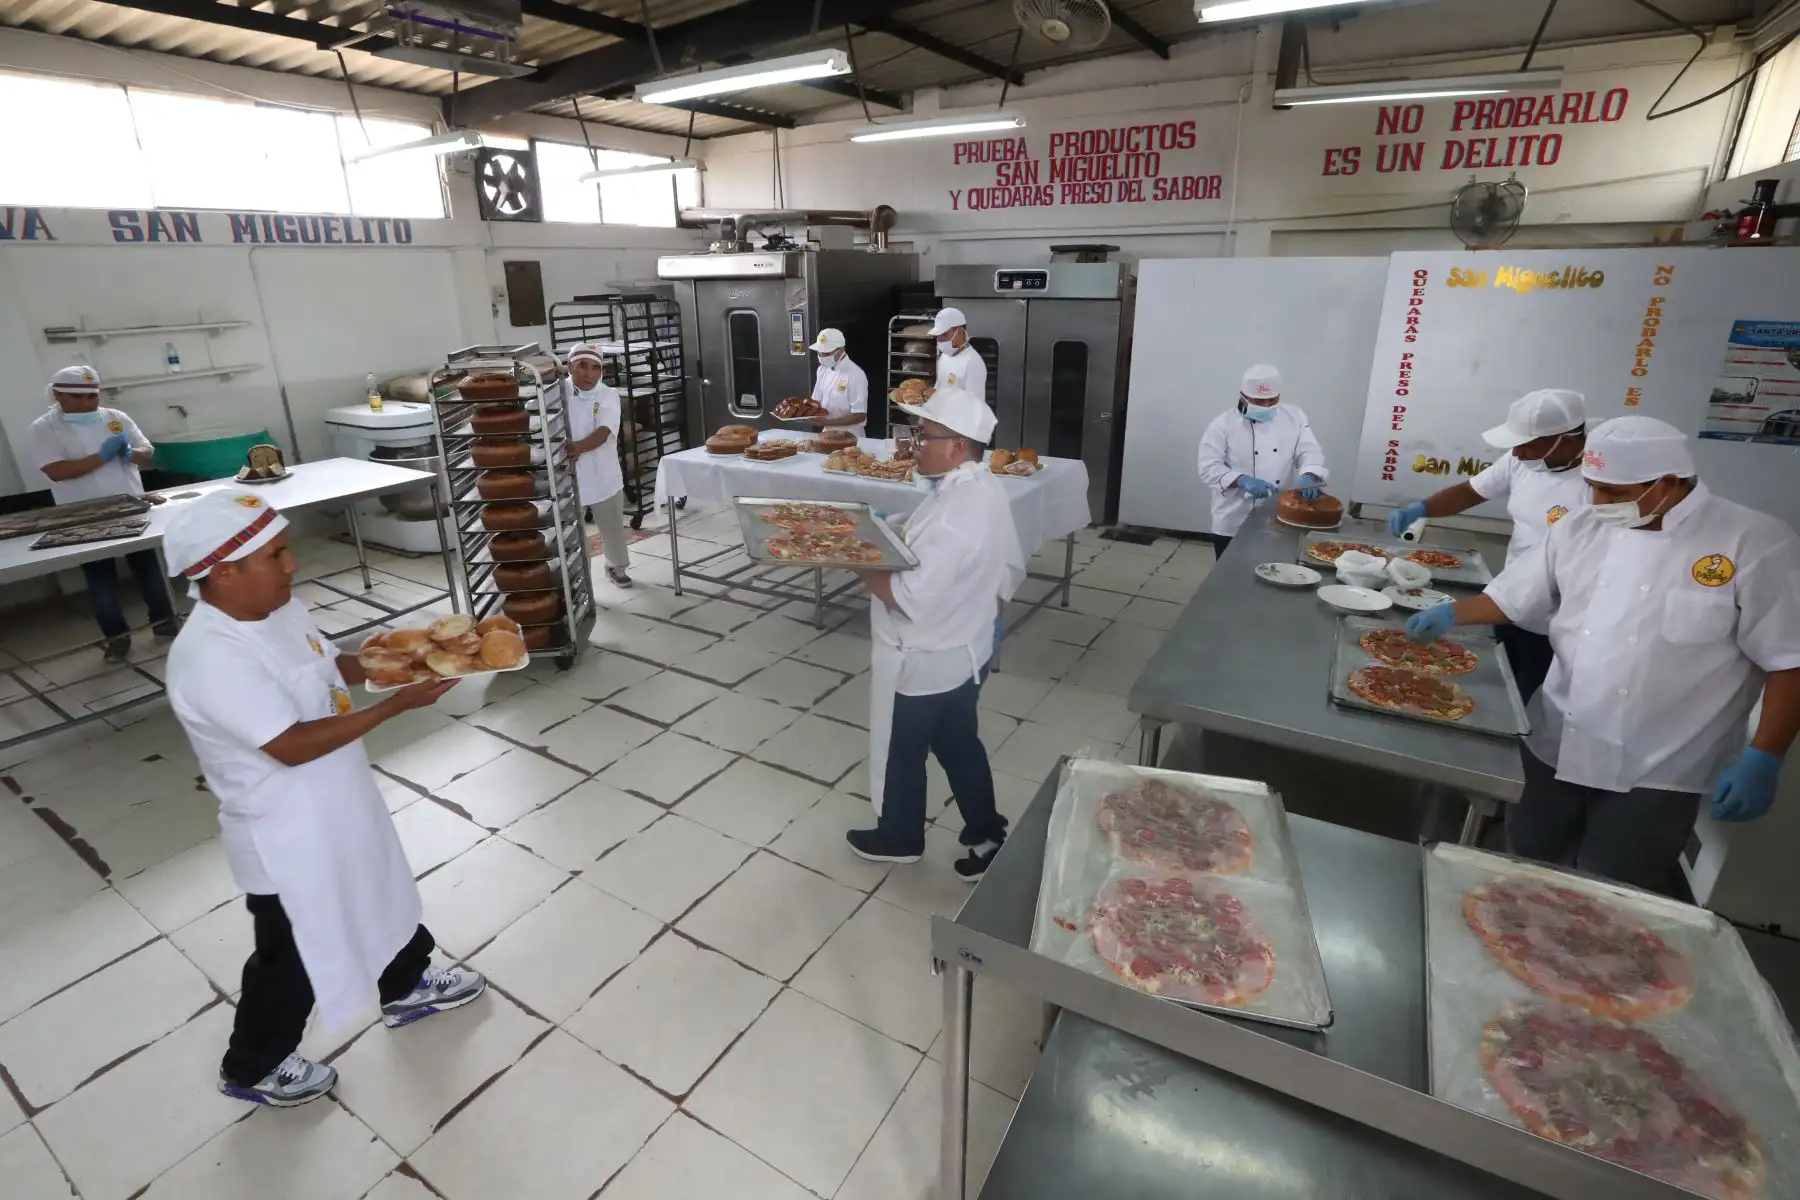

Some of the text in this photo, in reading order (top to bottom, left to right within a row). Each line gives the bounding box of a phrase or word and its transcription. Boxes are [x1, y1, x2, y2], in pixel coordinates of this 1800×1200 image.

[1374, 87, 1629, 135] NO PROBARLO
[953, 121, 1196, 165] PRUEBA PRODUCTOS
[1321, 133, 1563, 176] ES UN DELITO
[996, 151, 1160, 187] SAN MIGUELITO
[949, 174, 1222, 211] Y QUEDARAS PRESO DEL SABOR
[107, 210, 203, 243] SAN
[226, 212, 412, 244] MIGUELITO
[1444, 264, 1604, 295] San Miguelito
[1631, 296, 1666, 377] PROBARLO
[1395, 353, 1414, 396] PRESO
[1391, 405, 1407, 431] DEL
[1381, 439, 1400, 481] SABOR
